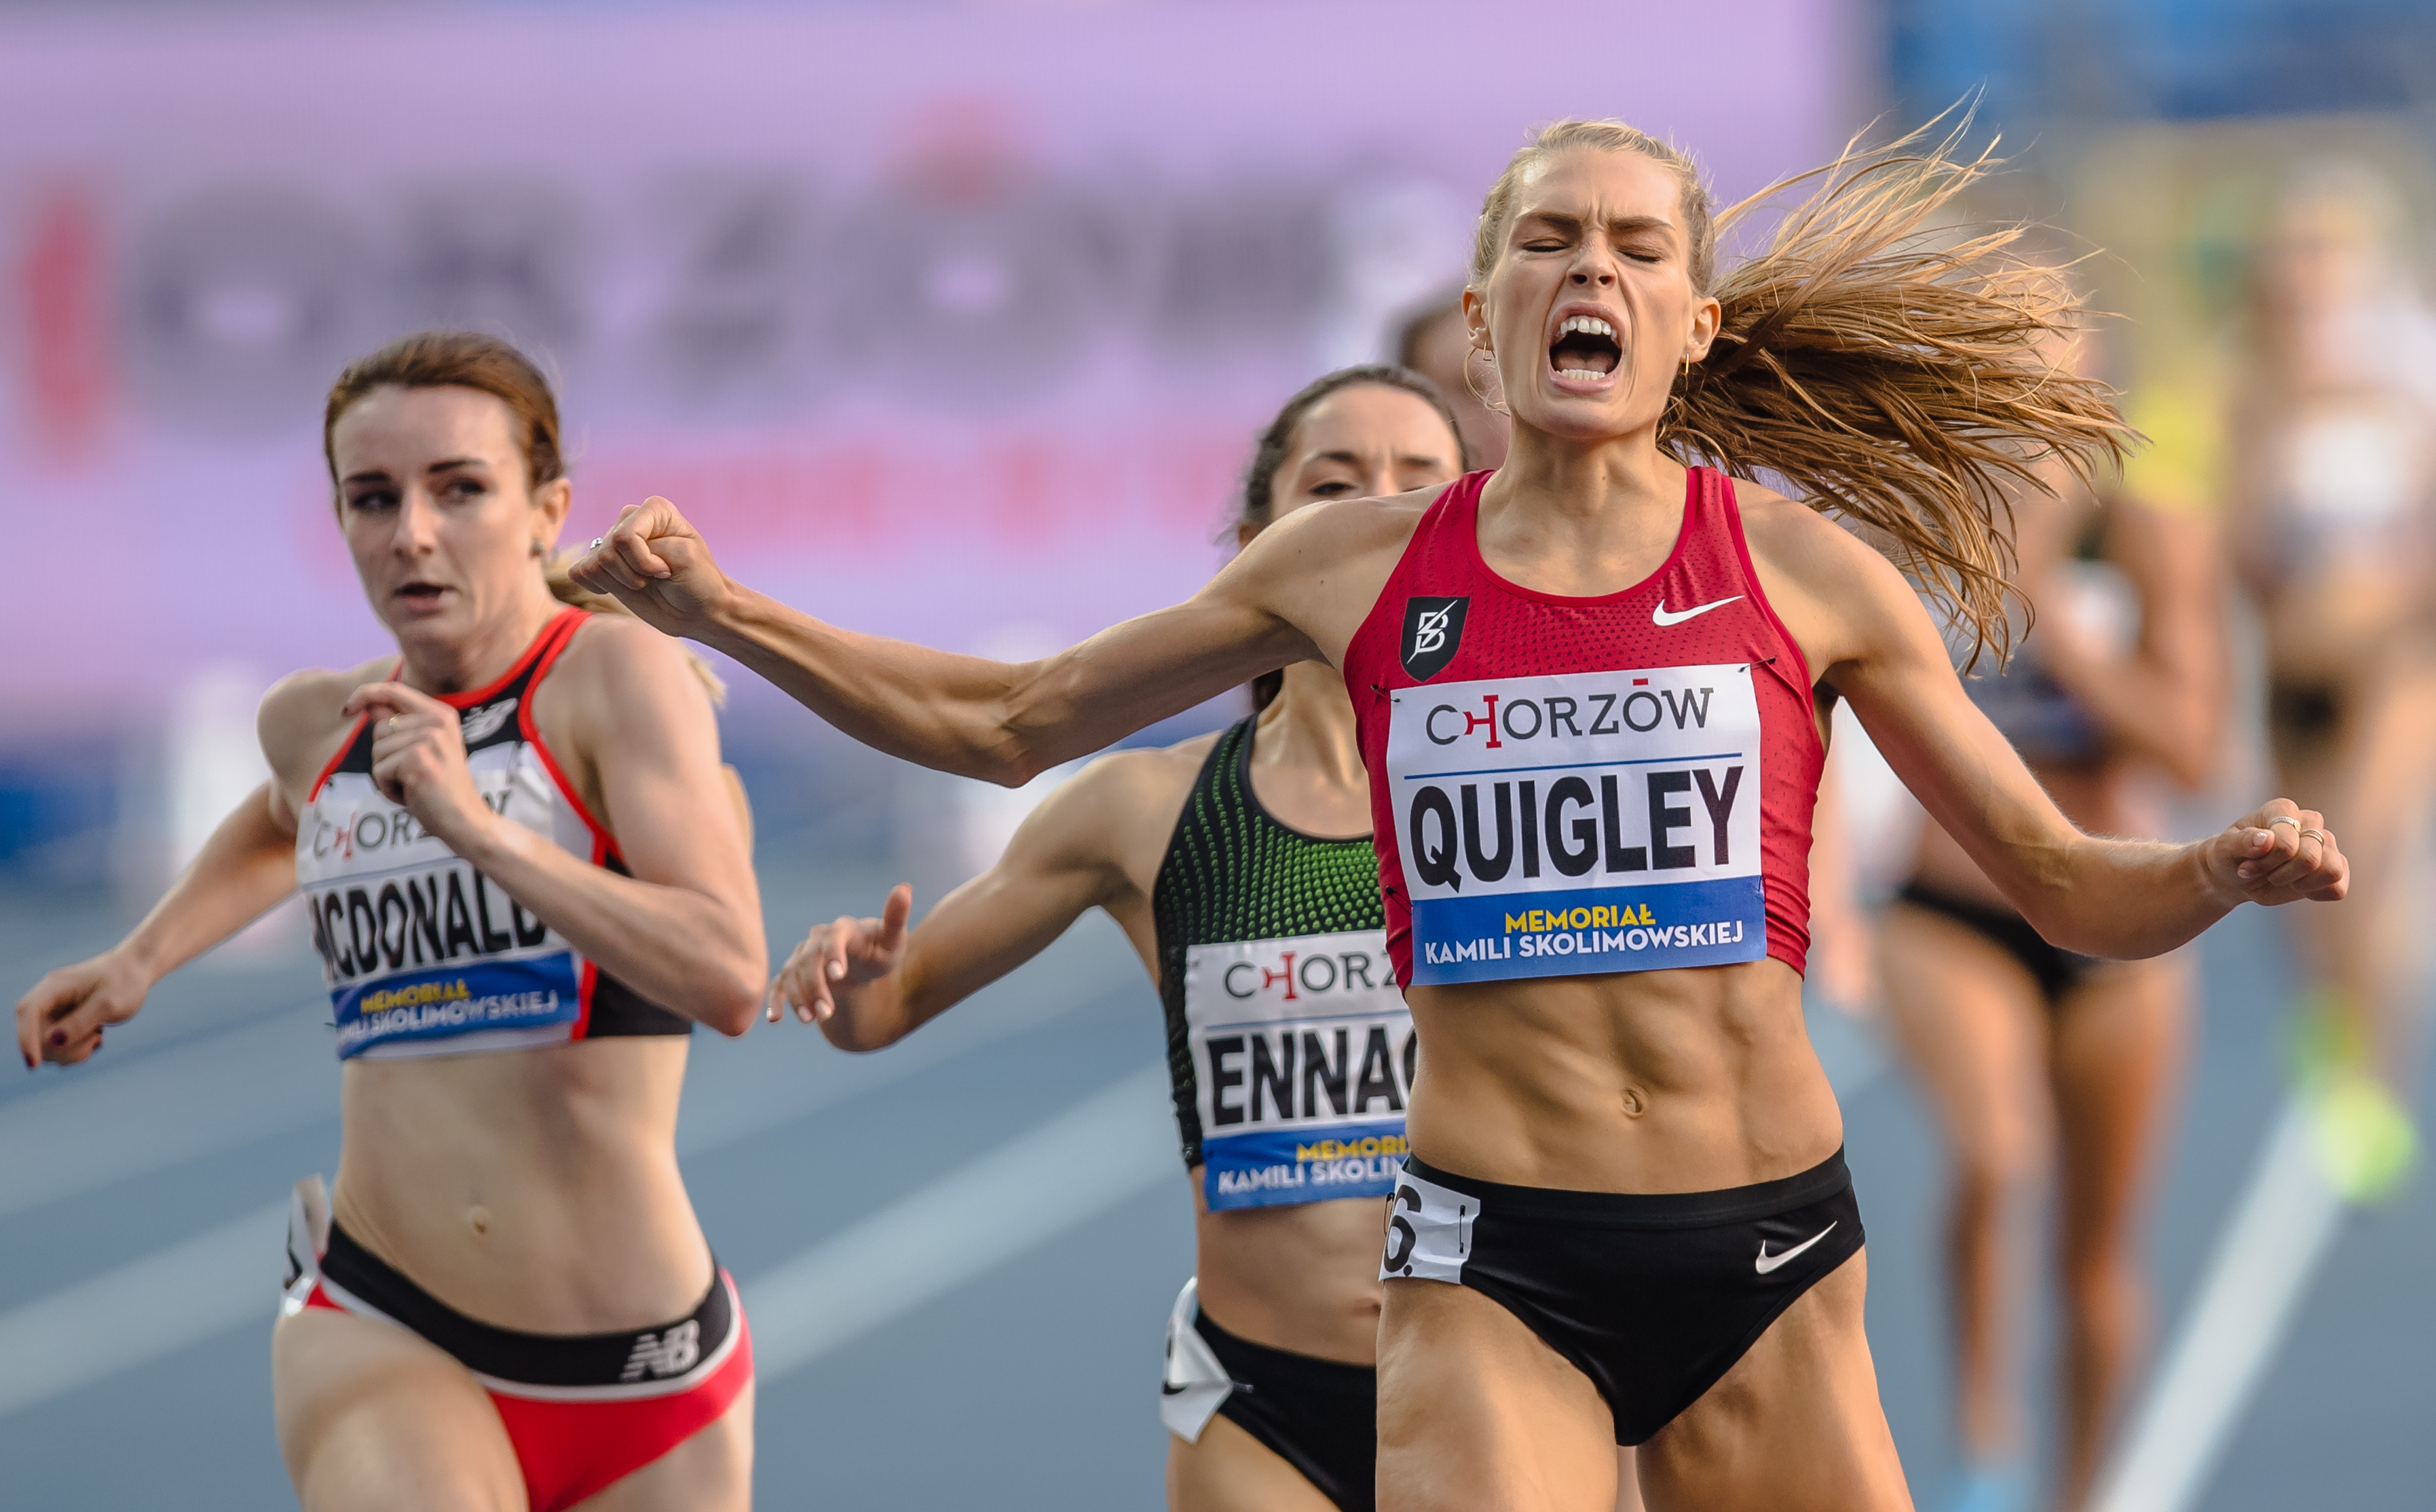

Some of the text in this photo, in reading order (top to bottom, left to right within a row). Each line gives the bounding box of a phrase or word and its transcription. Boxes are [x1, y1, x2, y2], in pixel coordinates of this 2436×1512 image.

[1425, 679, 1714, 749] CHORZÓW
[1409, 766, 1744, 893] QUIGLEY
[1505, 903, 1657, 934] MEMORIAŁ
[1425, 920, 1744, 964] KAMILI SKOLIMOWSKIEJ
[1218, 1164, 1305, 1194] KAMILI
